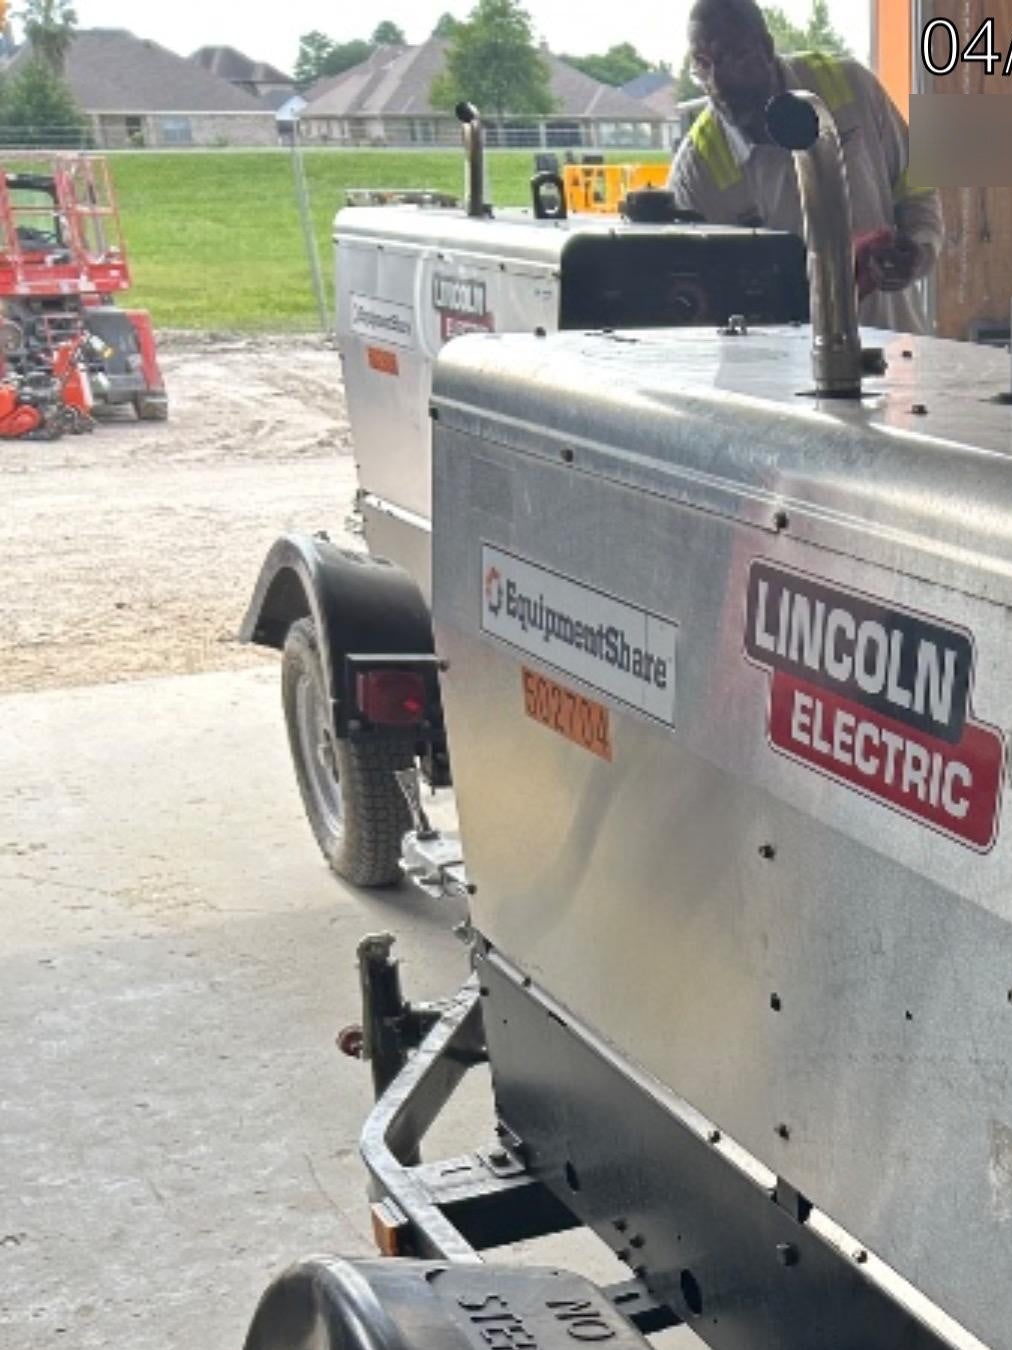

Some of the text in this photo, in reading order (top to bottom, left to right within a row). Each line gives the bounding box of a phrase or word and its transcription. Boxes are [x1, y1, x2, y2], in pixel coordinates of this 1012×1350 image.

[505, 578, 668, 691] EquipmentShare
[754, 580, 957, 726] LINCOLN
[525, 675, 609, 749] 502704
[791, 687, 973, 820] ELECTRIC
[544, 1301, 617, 1342] NO
